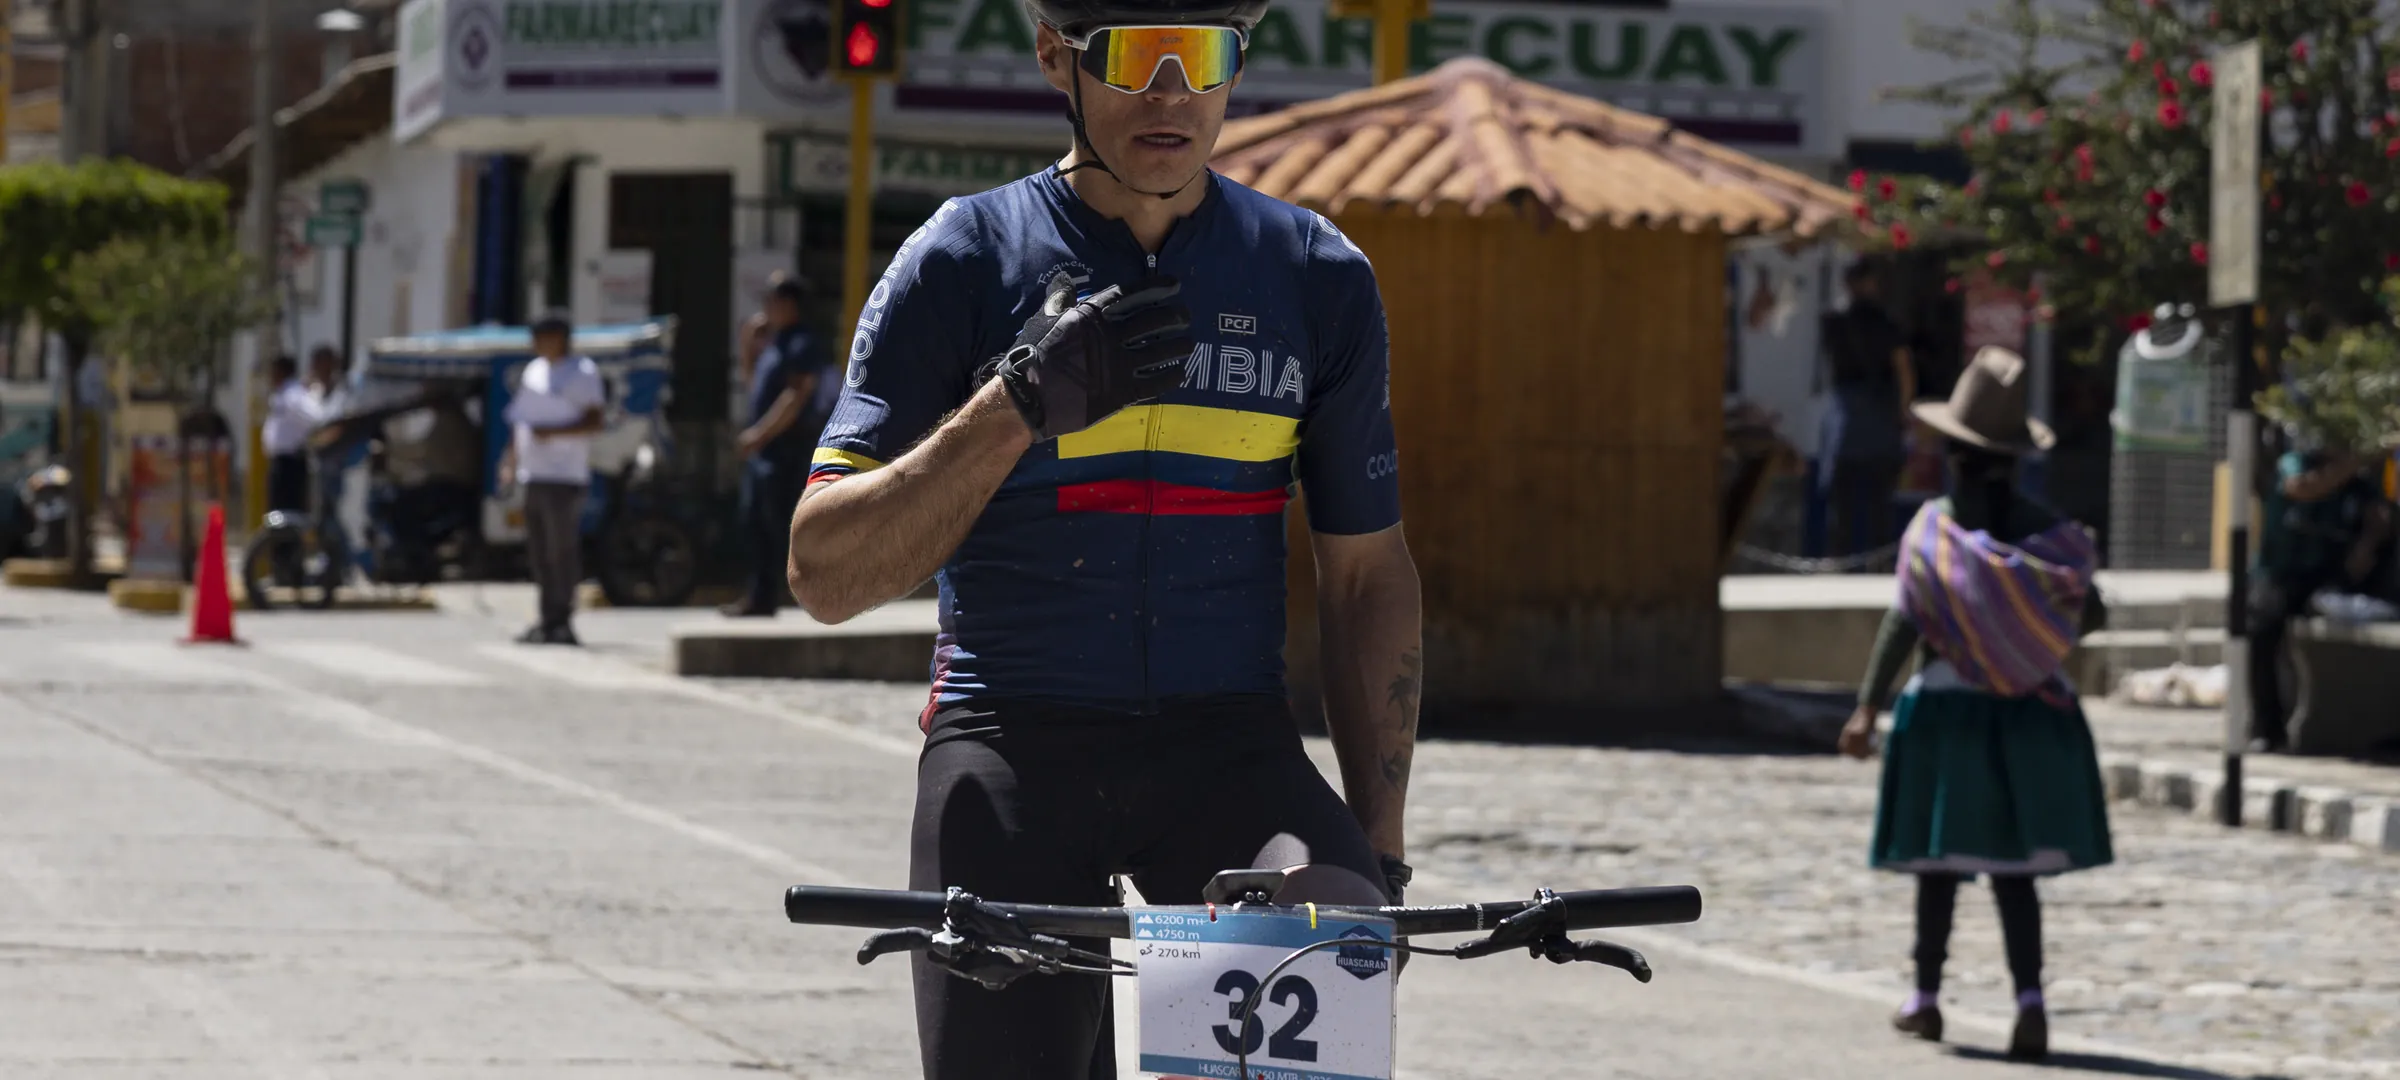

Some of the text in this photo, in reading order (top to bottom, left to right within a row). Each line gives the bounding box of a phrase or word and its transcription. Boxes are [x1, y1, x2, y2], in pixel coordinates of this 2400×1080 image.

[906, 0, 1805, 88] FAARECUAY
[846, 199, 959, 388] COLOMBIA
[1223, 317, 1251, 330] PCF
[1155, 915, 1184, 926] 6200
[1156, 928, 1200, 941] 4750 m
[1158, 948, 1201, 959] 270 km
[1211, 969, 1318, 1062] 32
[1199, 1063, 1256, 1079] HUASCARN
